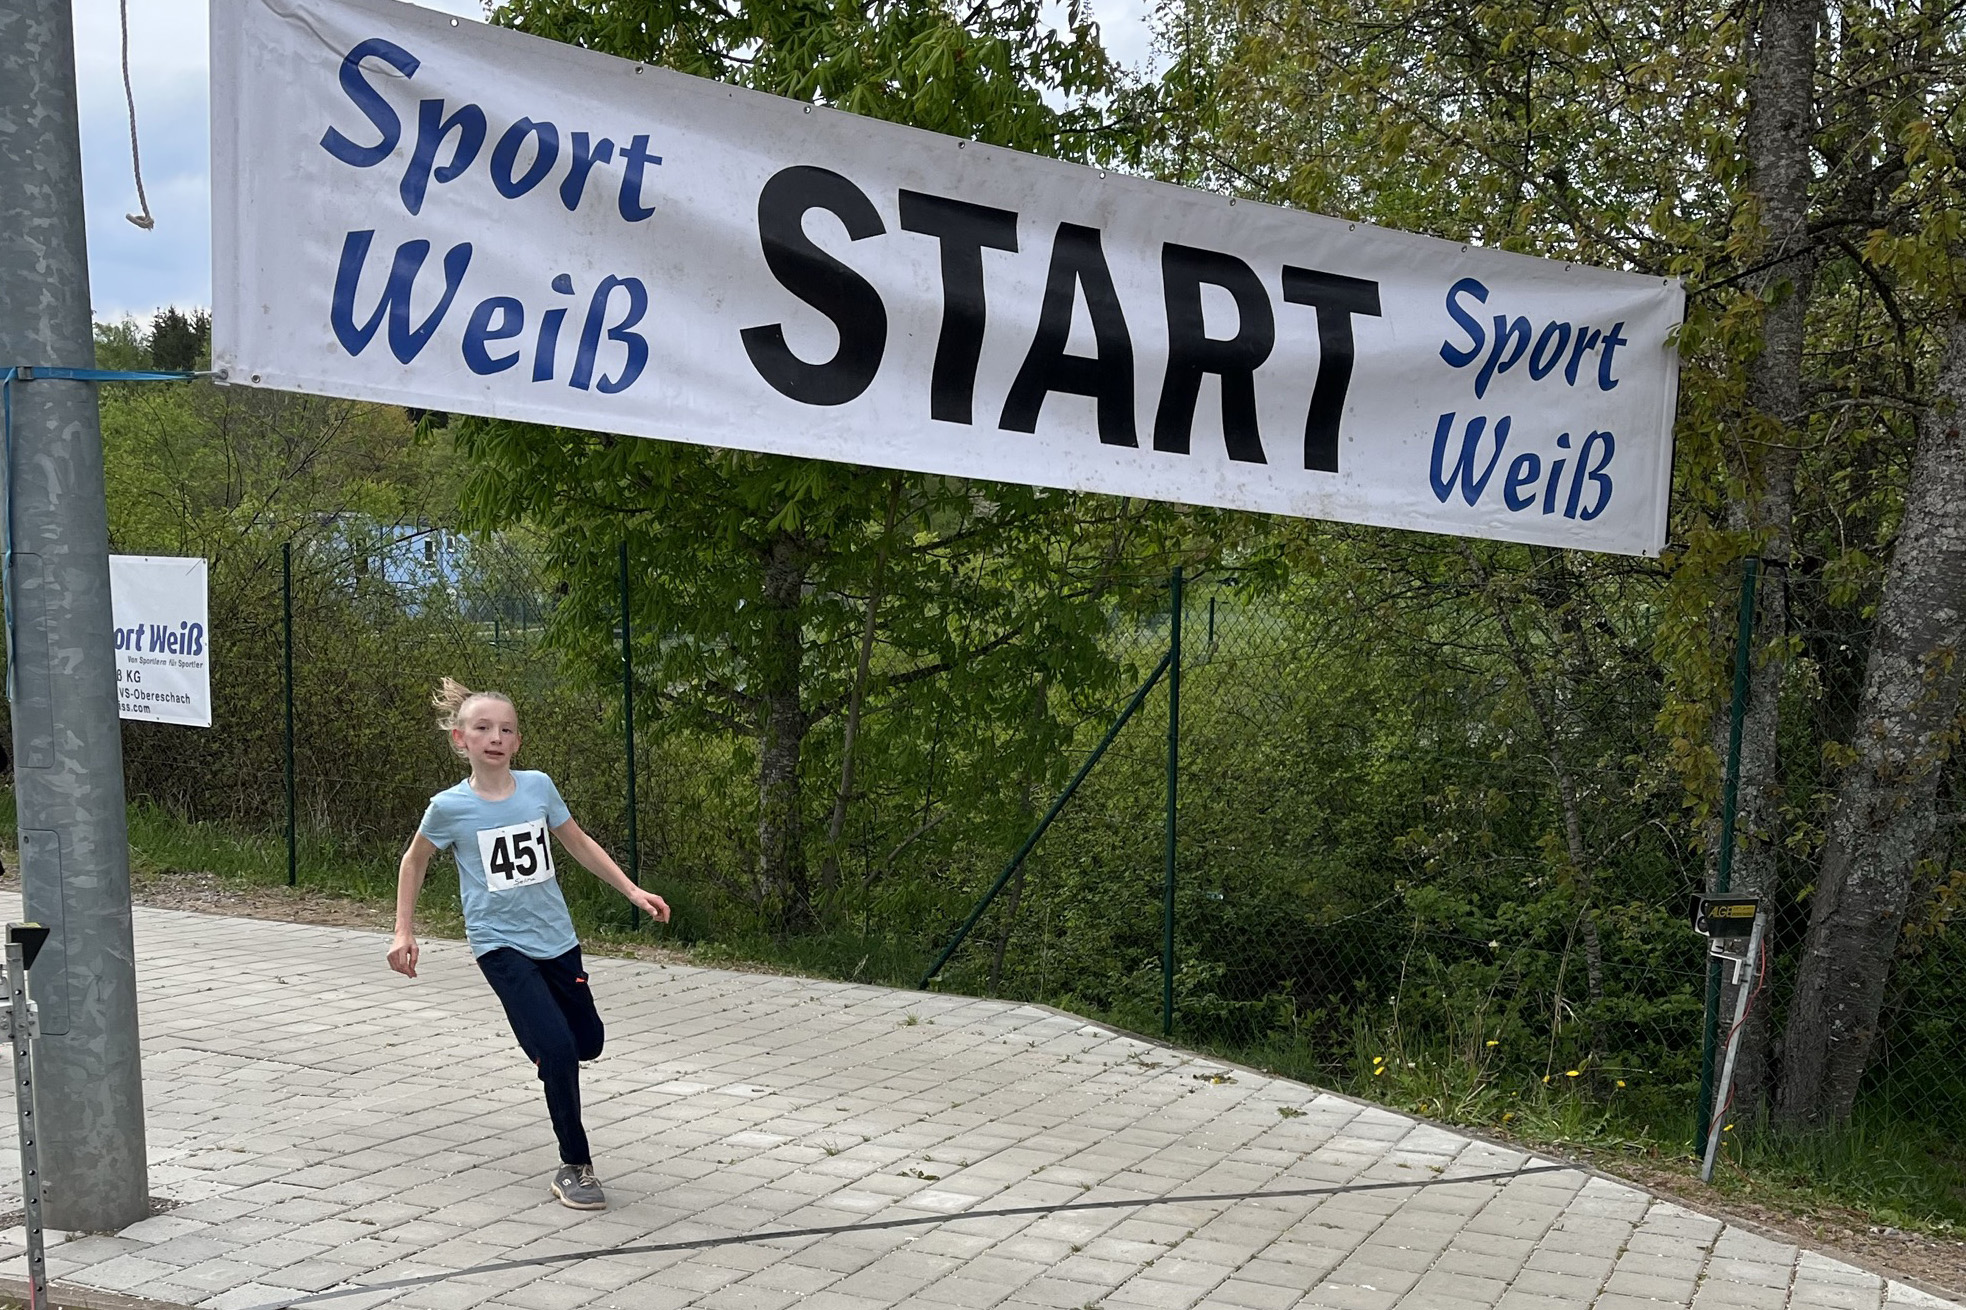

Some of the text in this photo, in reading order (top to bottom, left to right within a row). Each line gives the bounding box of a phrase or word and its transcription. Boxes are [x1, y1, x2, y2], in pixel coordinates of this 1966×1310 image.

[319, 38, 663, 222] Sport
[330, 229, 649, 394] Weiß
[740, 165, 1382, 473] START
[1439, 277, 1628, 400] Sport
[1429, 411, 1616, 521] Weiß
[126, 669, 141, 684] KG
[139, 656, 167, 666] Sportlern
[178, 660, 203, 669] Sportler
[149, 621, 203, 656] Weiß
[119, 687, 191, 705] VS-Obereschach
[490, 827, 549, 880] 451
